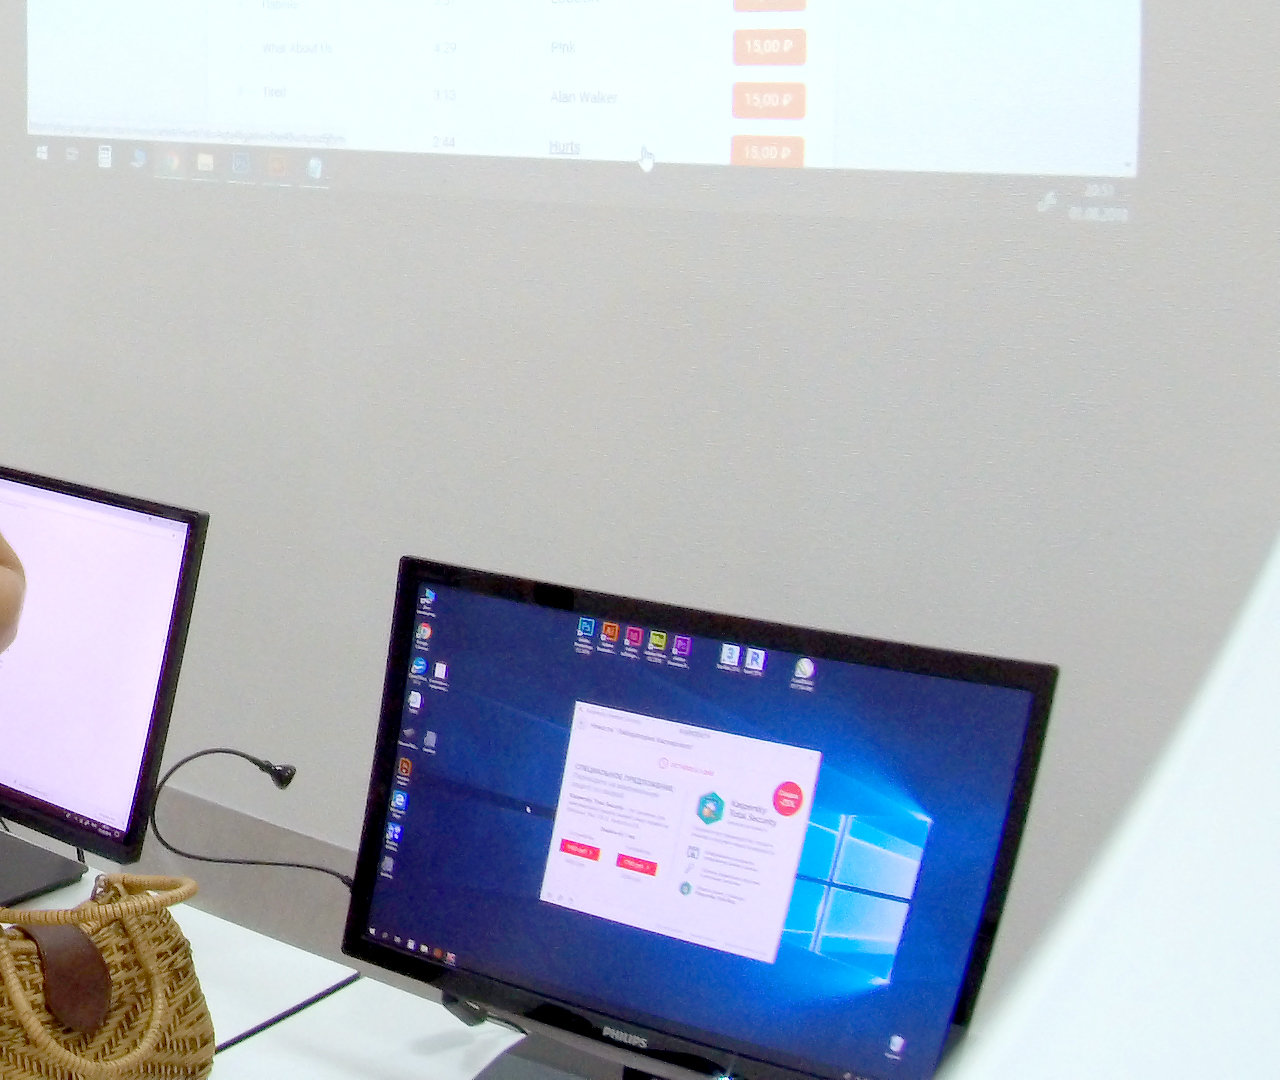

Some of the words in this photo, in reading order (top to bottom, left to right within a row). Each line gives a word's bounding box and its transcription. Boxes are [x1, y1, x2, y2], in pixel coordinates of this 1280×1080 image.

[744, 40, 779, 54] 15,00
[550, 91, 576, 104] Alan
[579, 91, 618, 104] Walker
[743, 93, 778, 108] 15,00
[549, 140, 581, 154] Hurts
[743, 146, 778, 161] 15,00
[602, 1026, 648, 1048] PHILIPS
